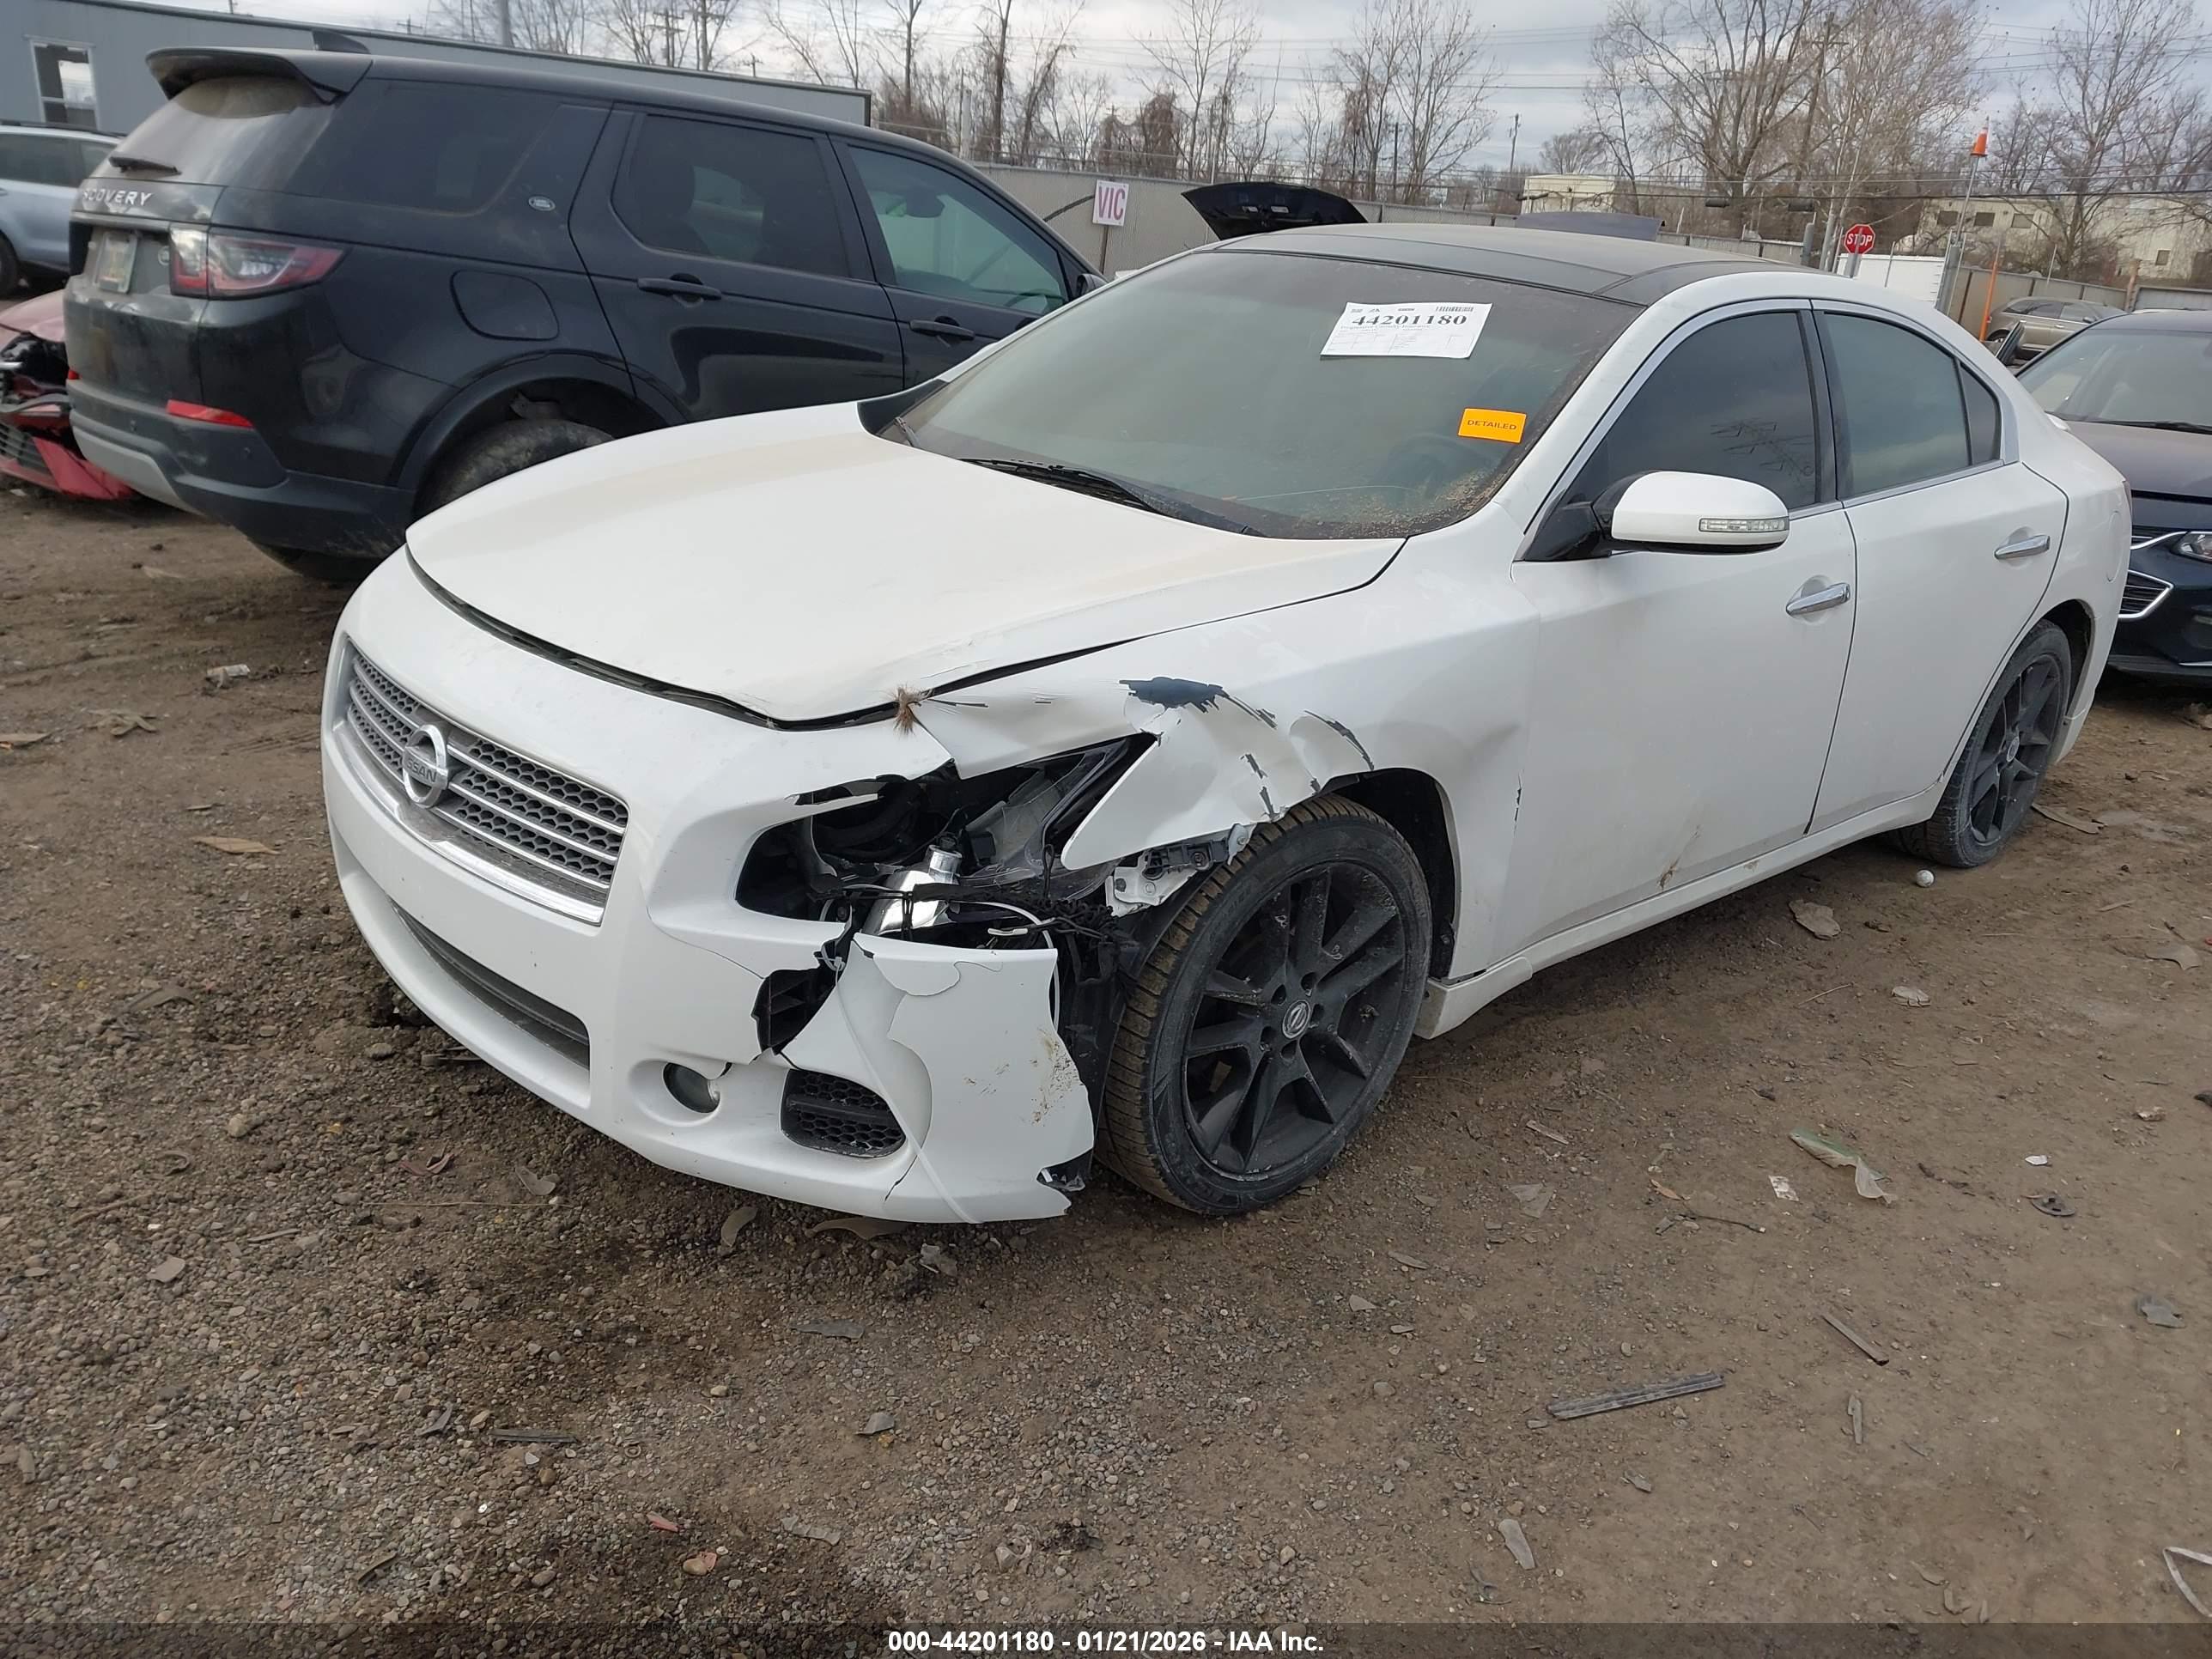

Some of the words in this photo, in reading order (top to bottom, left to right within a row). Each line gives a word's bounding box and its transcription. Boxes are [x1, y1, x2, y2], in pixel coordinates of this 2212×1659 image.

[1099, 185, 1126, 221] VIC
[1847, 233, 1873, 246] STOP
[1352, 314, 1468, 325] 44201180
[1468, 419, 1517, 430] DETAILED
